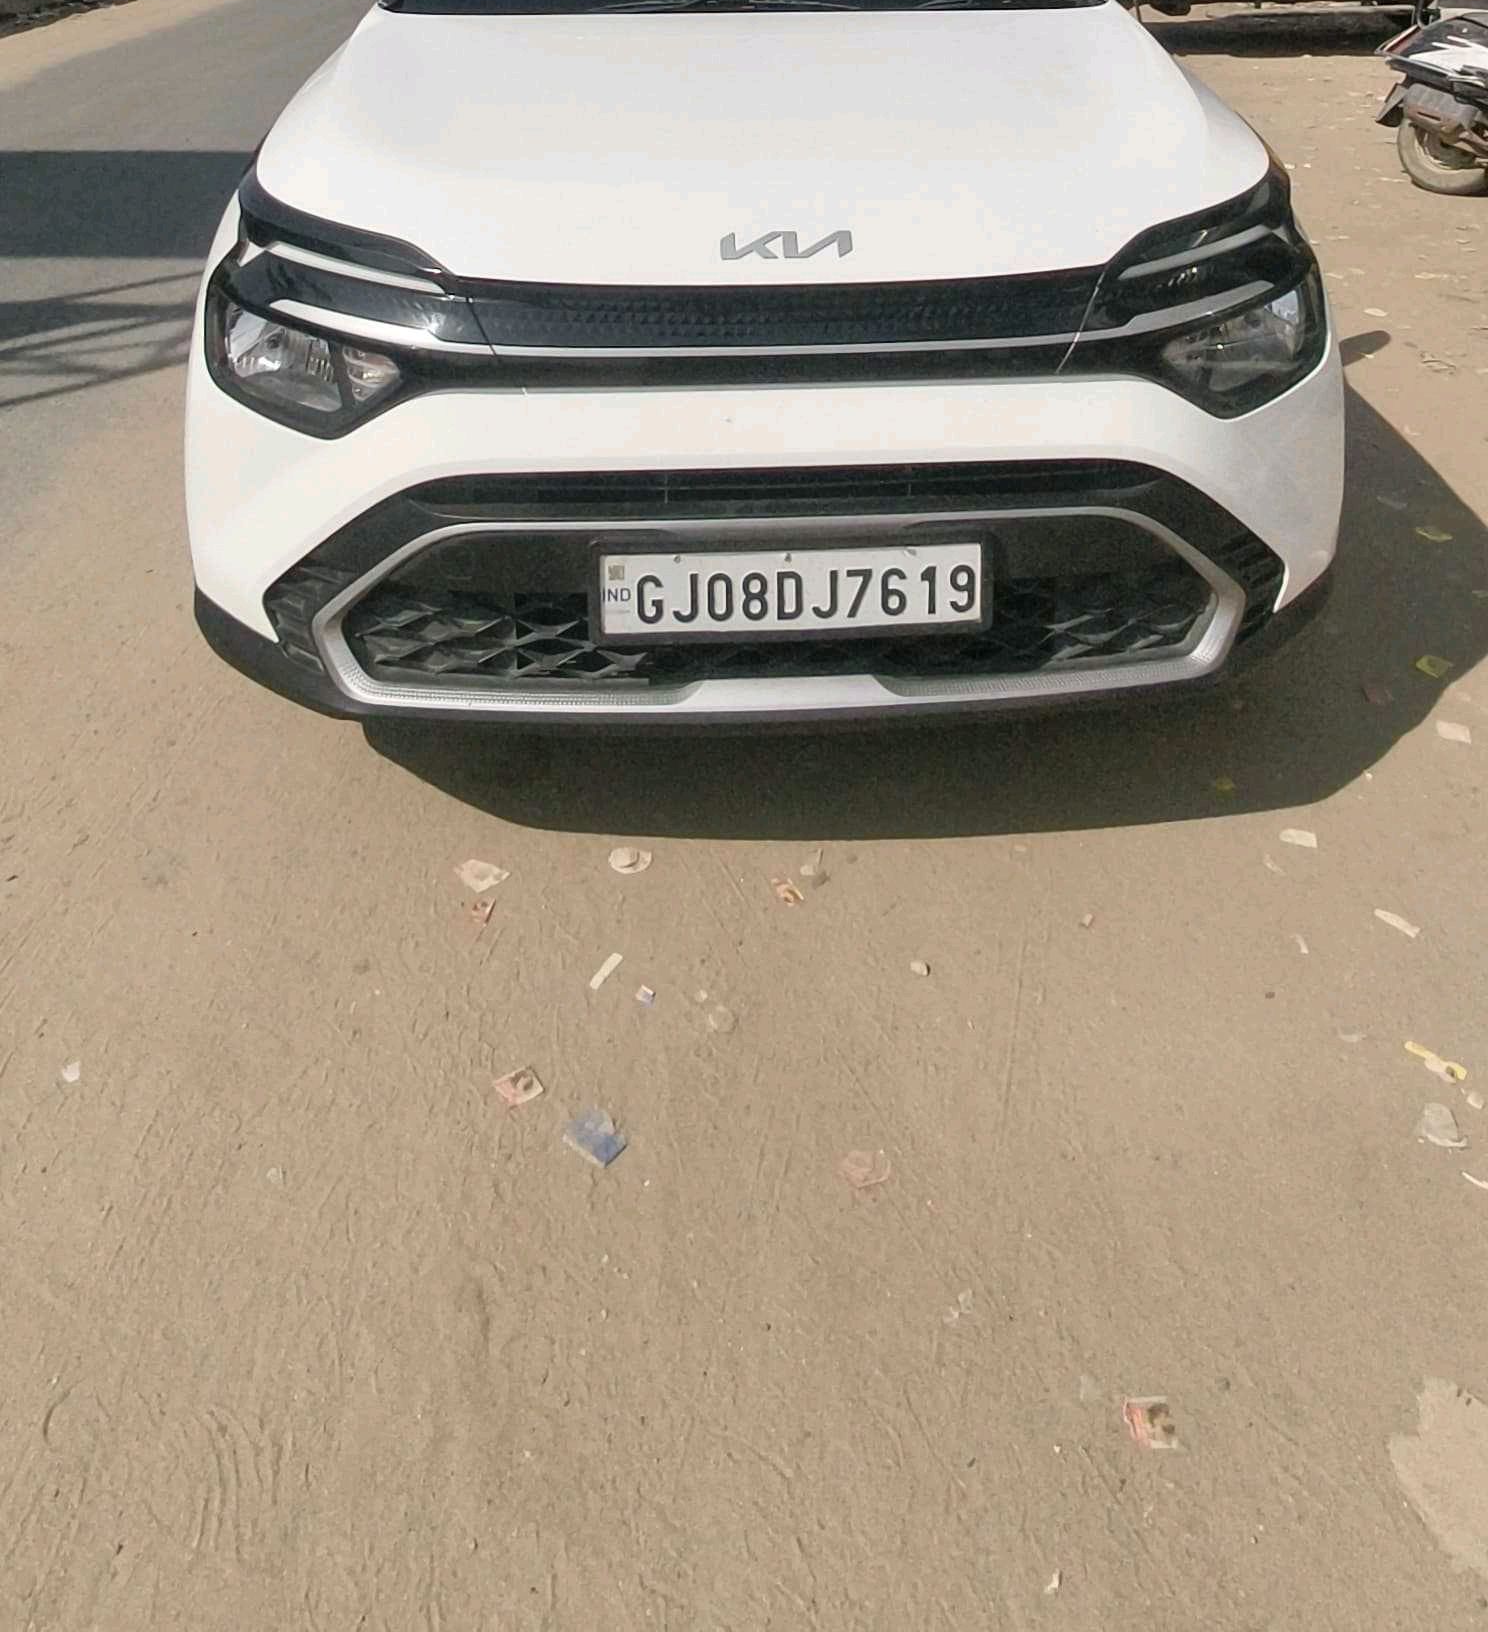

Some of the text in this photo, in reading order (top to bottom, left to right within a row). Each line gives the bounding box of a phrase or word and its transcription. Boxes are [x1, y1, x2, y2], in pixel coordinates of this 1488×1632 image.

[720, 229, 853, 260] KIA
[602, 564, 977, 624] IND GJ08DJ7619
